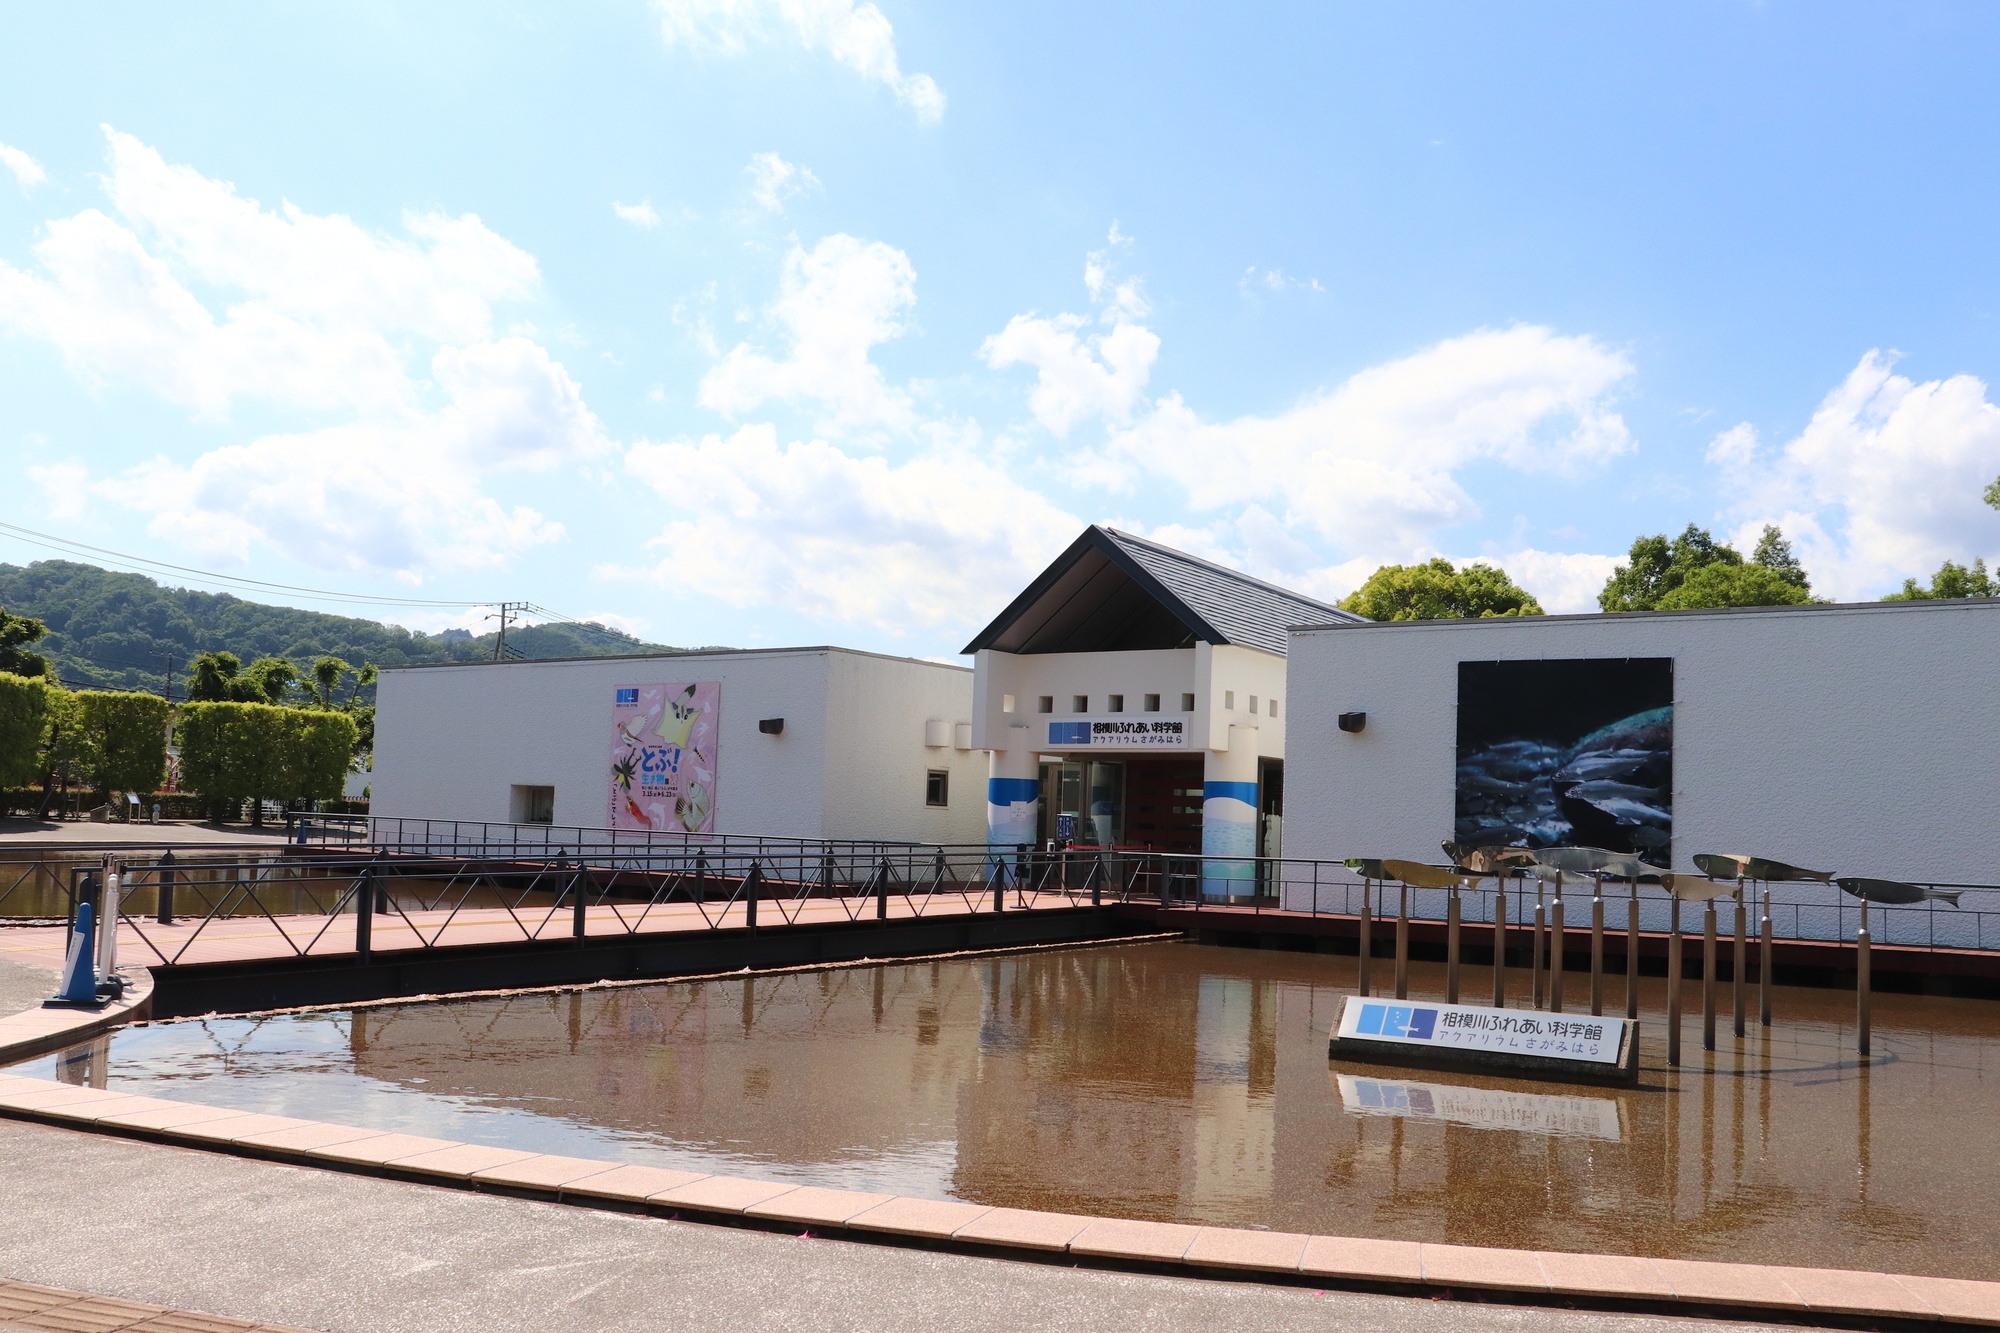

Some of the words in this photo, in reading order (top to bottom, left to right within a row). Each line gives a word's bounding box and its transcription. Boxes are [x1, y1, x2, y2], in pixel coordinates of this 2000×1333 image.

[1092, 722, 1183, 734] 相模川ふれあい科学館
[1092, 735, 1183, 744] アクアリウムさがみはら
[1441, 1011, 1604, 1041] 相模川ふれあい科学館
[1438, 1030, 1600, 1056] アクアリウムさがみはら
